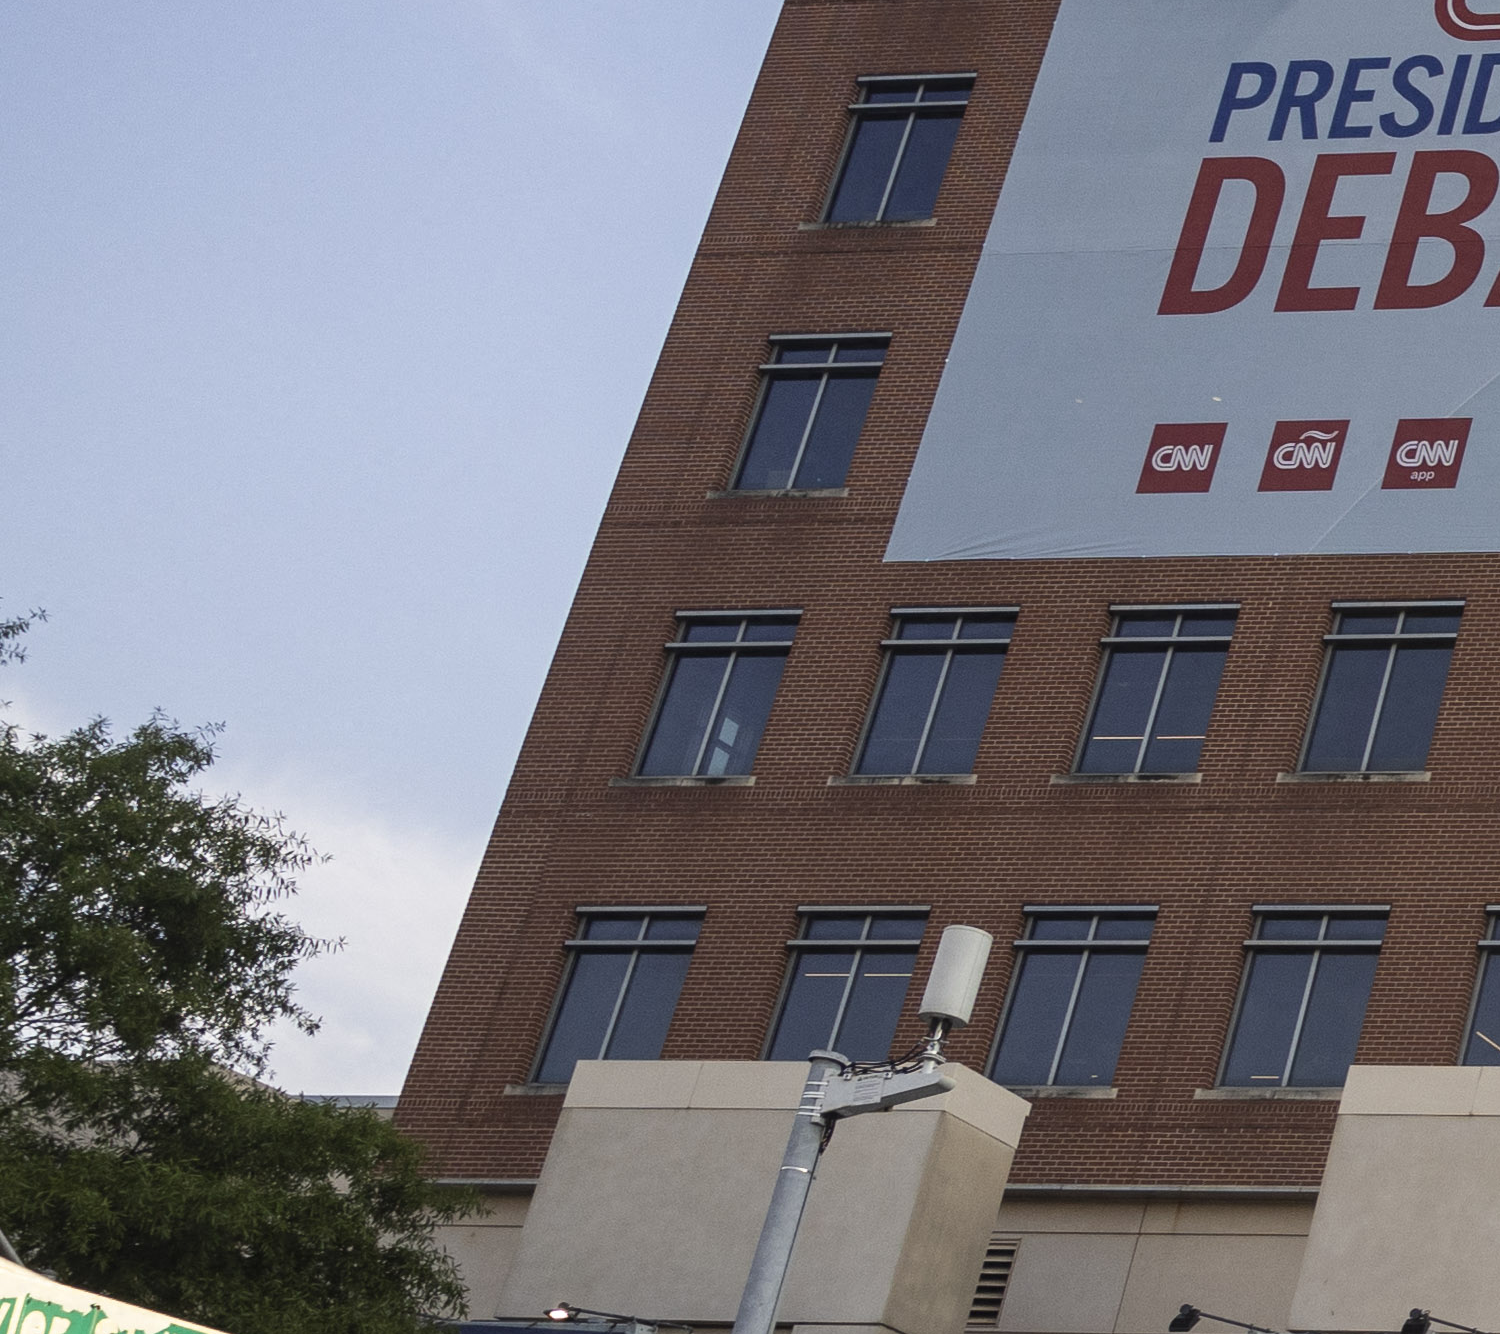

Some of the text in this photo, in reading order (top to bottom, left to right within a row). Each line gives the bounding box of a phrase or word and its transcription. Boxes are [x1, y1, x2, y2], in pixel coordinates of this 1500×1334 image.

[1152, 445, 1213, 471] CNN
[1396, 439, 1459, 466] CNN
[1410, 471, 1435, 482] app
